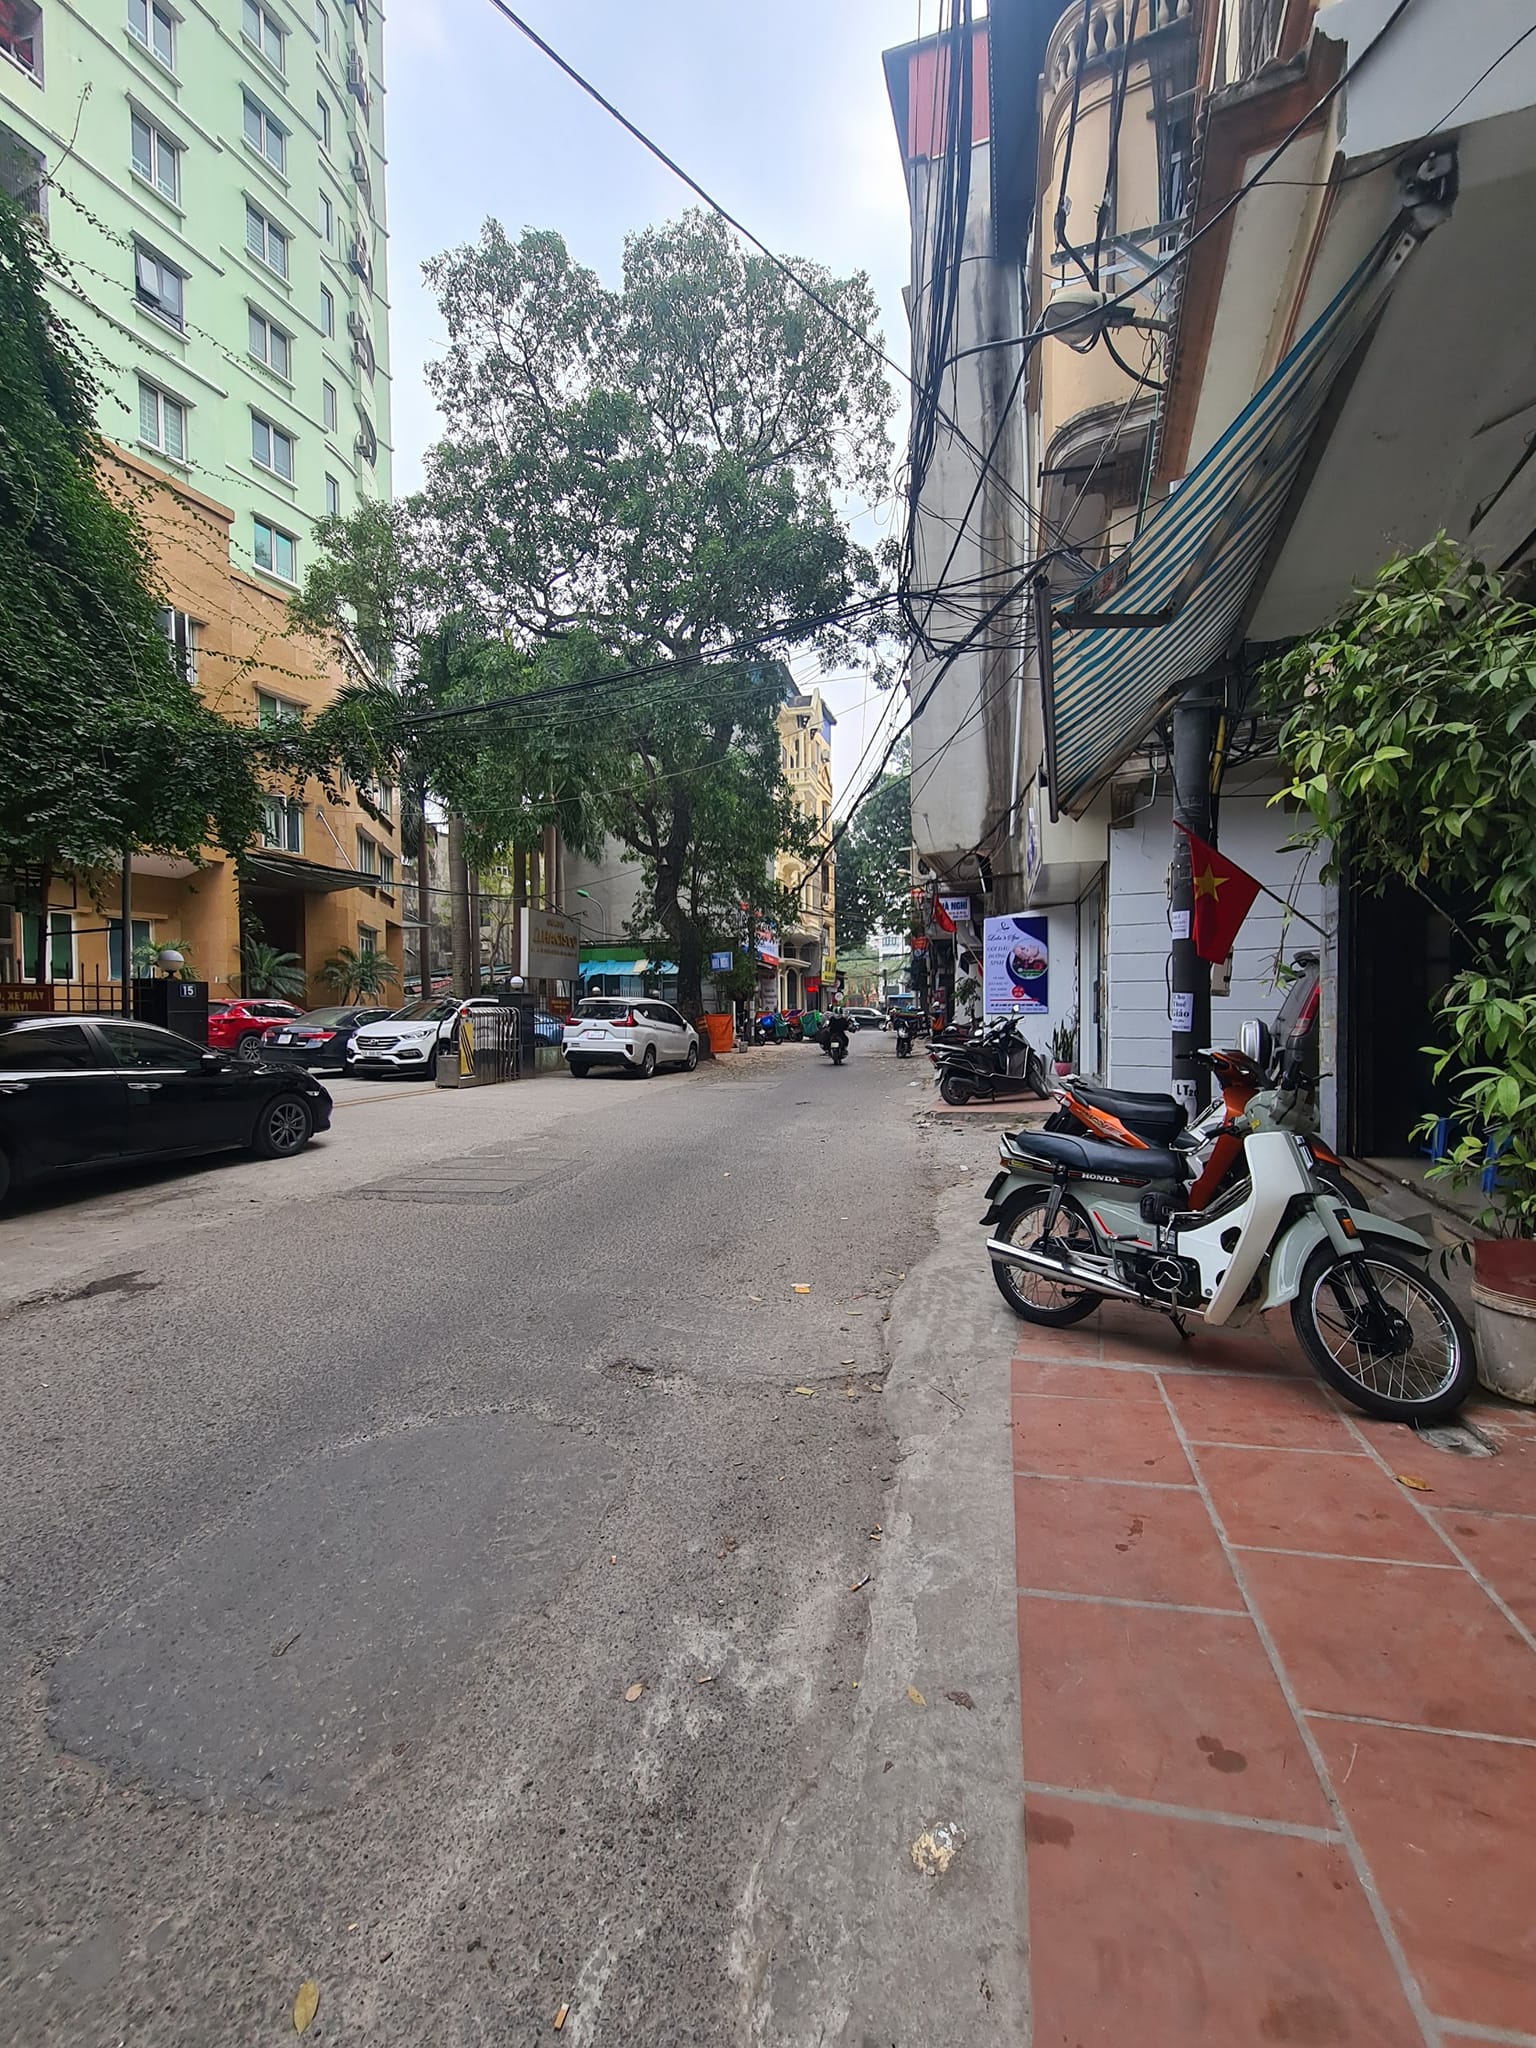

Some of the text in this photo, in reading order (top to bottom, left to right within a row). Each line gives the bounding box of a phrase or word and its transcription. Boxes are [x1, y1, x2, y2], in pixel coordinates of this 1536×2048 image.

[7, 991, 21, 1000] XE
[183, 985, 194, 996] 15
[1081, 1172, 1120, 1183] HONDA
